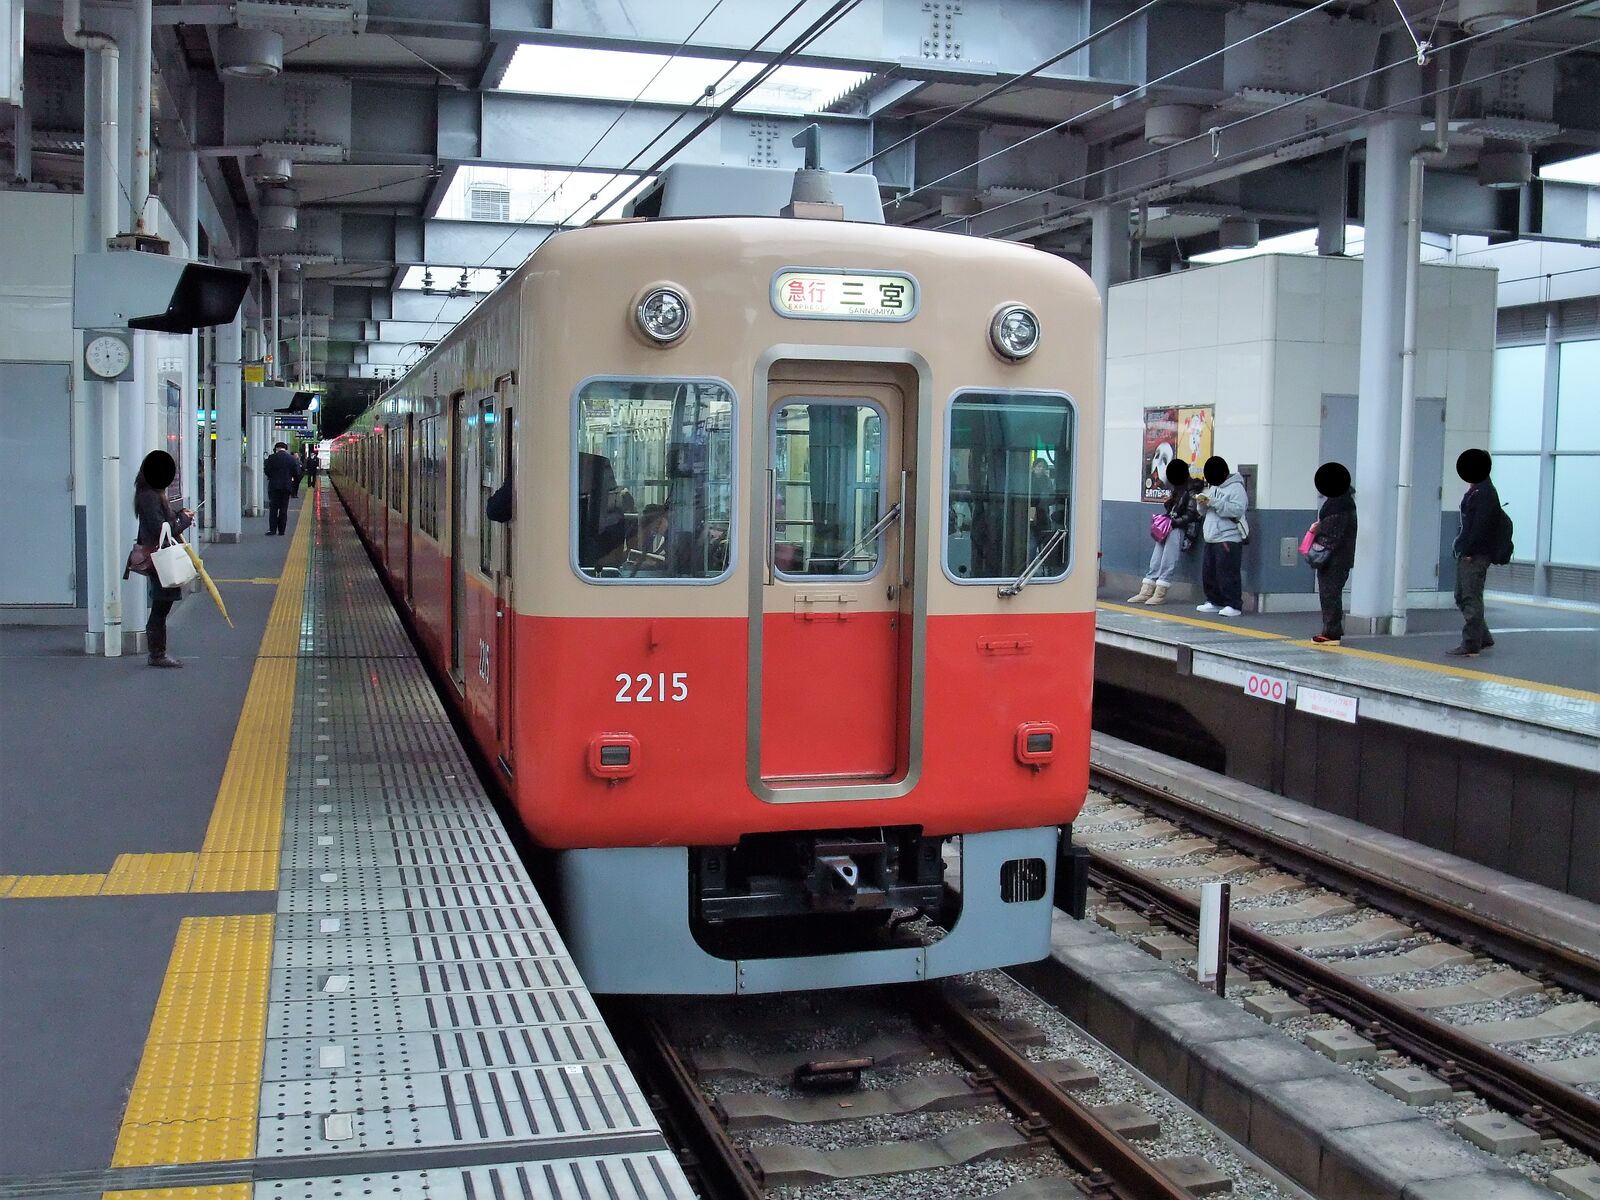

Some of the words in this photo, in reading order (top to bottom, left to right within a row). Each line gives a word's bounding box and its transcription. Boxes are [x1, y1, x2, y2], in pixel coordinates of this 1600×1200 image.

[788, 280, 826, 303] 急行
[840, 282, 905, 308] 三宮
[849, 307, 896, 316] SANNOMIYA
[615, 672, 689, 702] 2215
